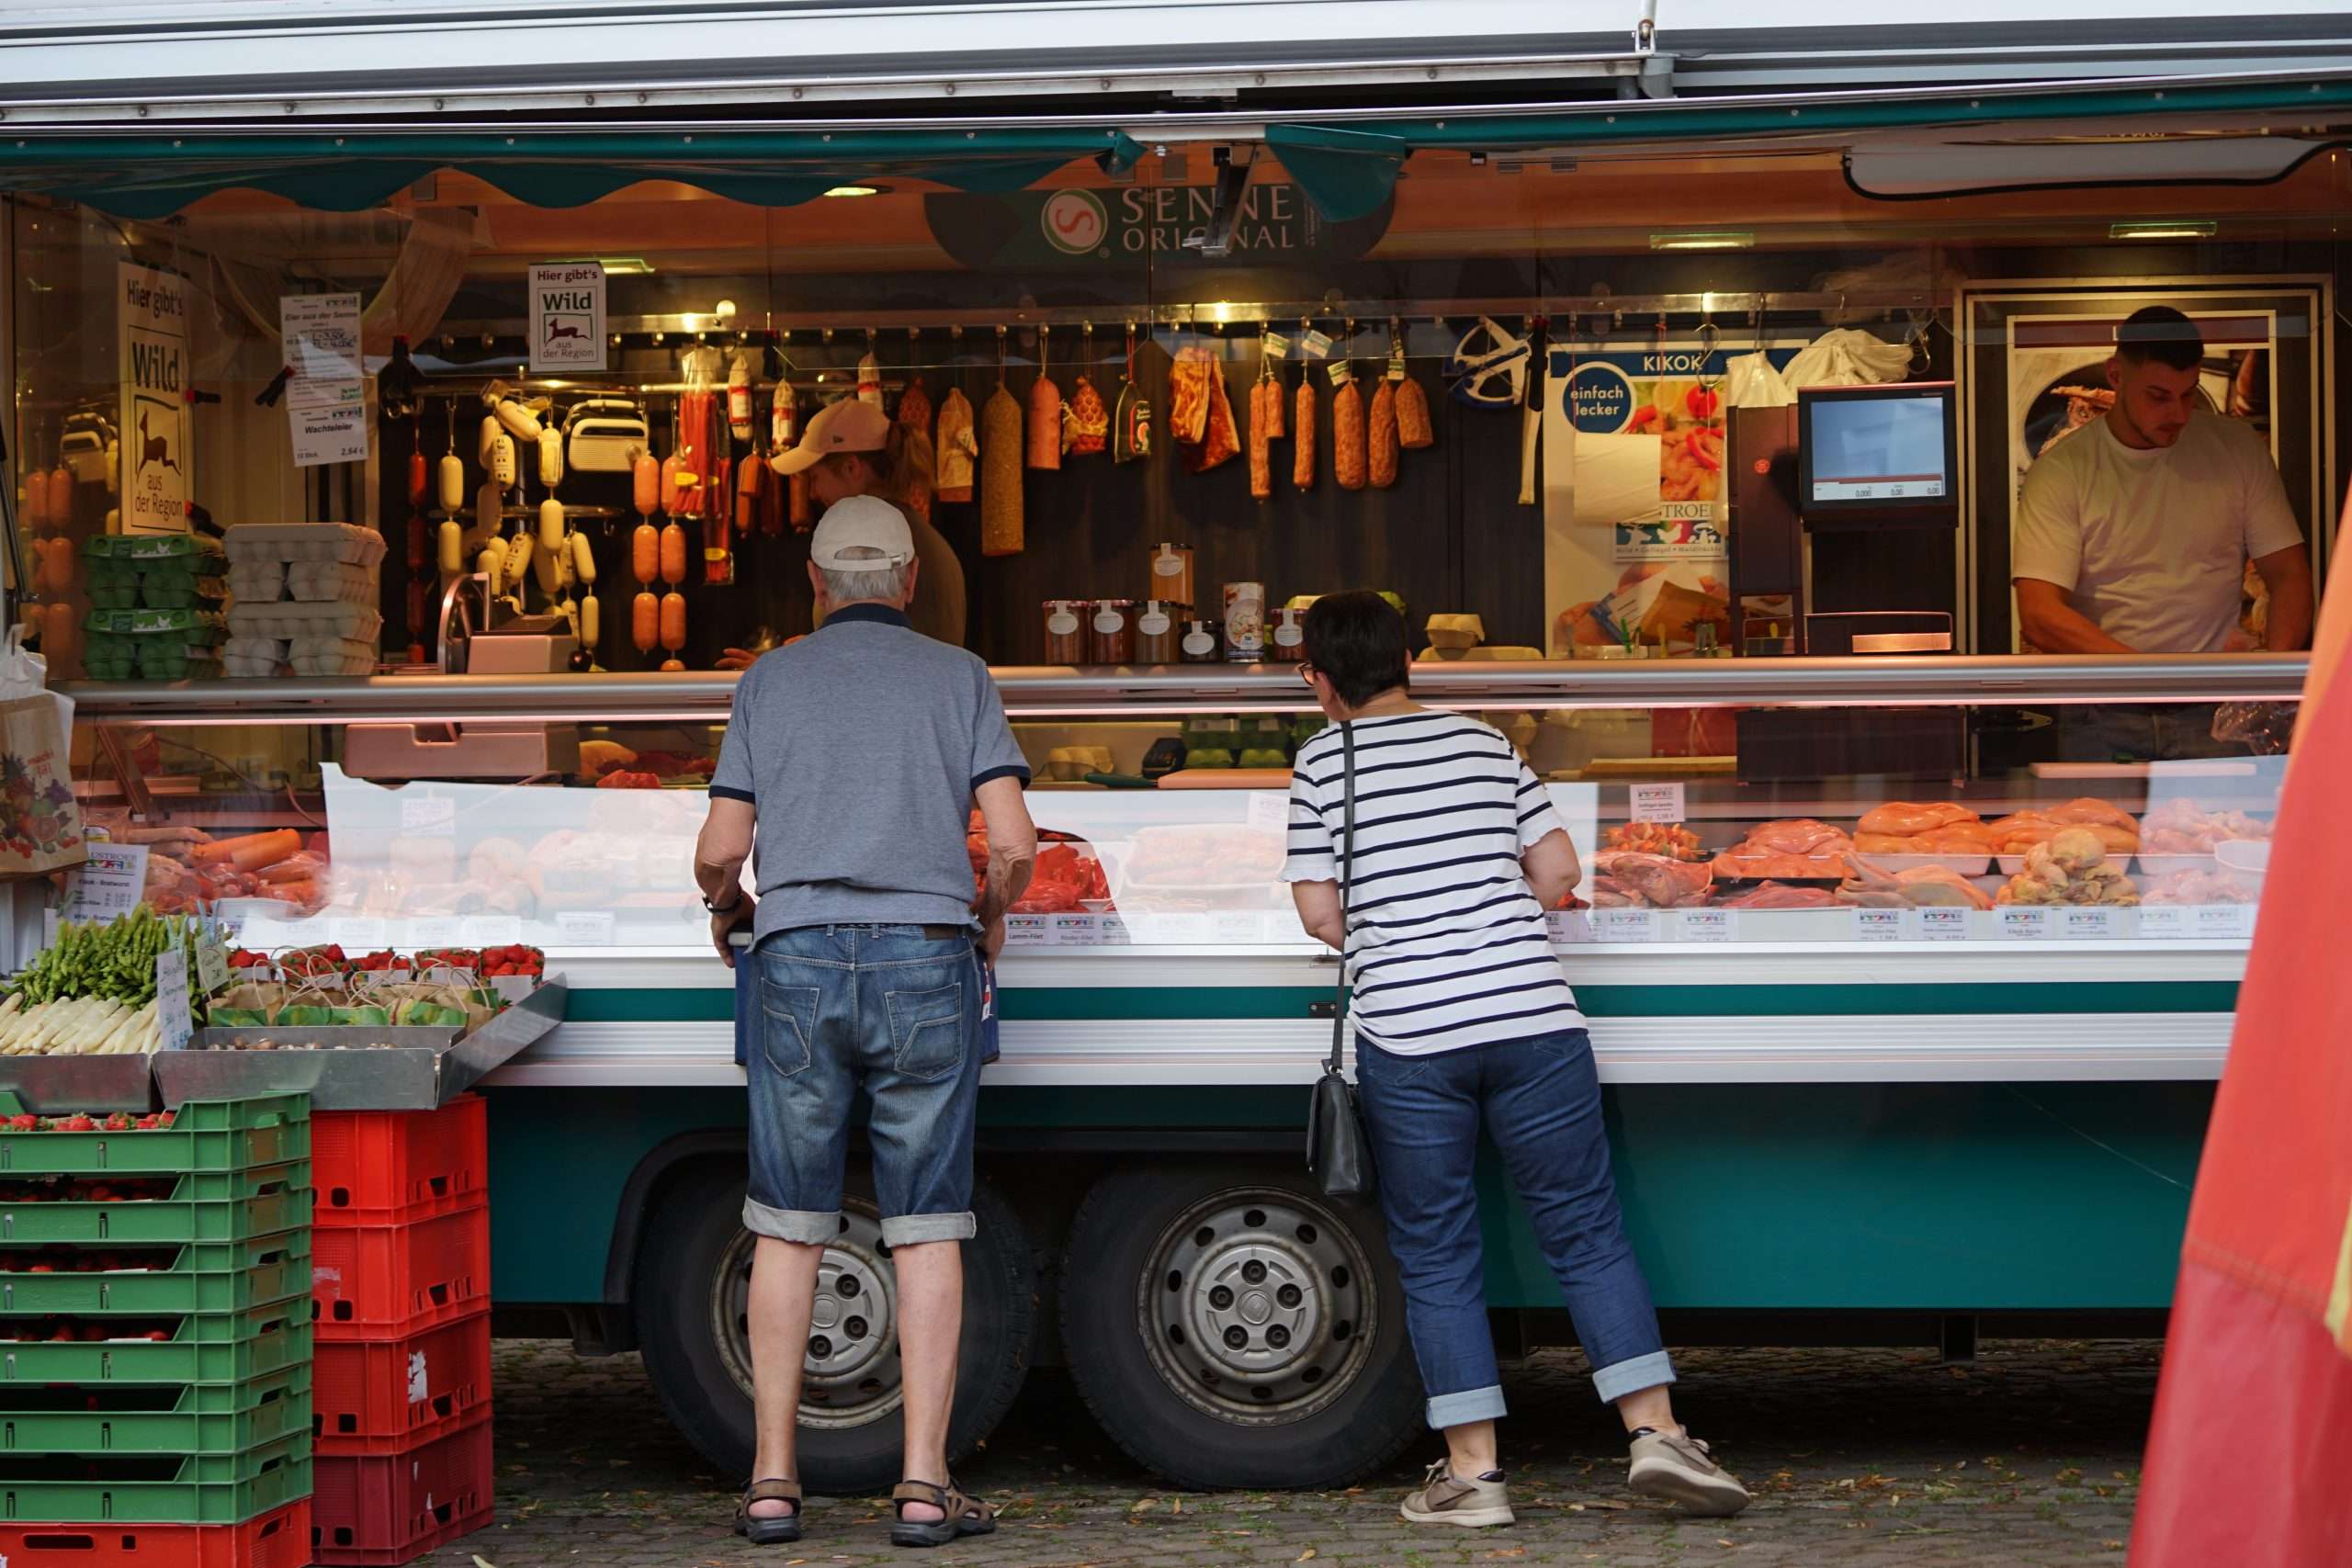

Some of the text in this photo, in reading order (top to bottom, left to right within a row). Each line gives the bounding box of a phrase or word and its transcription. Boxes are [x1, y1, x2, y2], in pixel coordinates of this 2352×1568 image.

[1123, 225, 1295, 251] ORINAL
[537, 268, 598, 283] Hier gibt's
[127, 279, 183, 319] Hier gibt's
[542, 291, 592, 310] Wild
[543, 348, 594, 359] der Region
[132, 342, 179, 393] Wild
[1643, 355, 1703, 371] KIKOK
[1570, 385, 1623, 400] einfach
[1575, 401, 1620, 417] lecker
[305, 423, 353, 434] Wachteleier
[147, 473, 163, 491] aus
[135, 490, 183, 522] der Region
[1660, 503, 1713, 518] TROE
